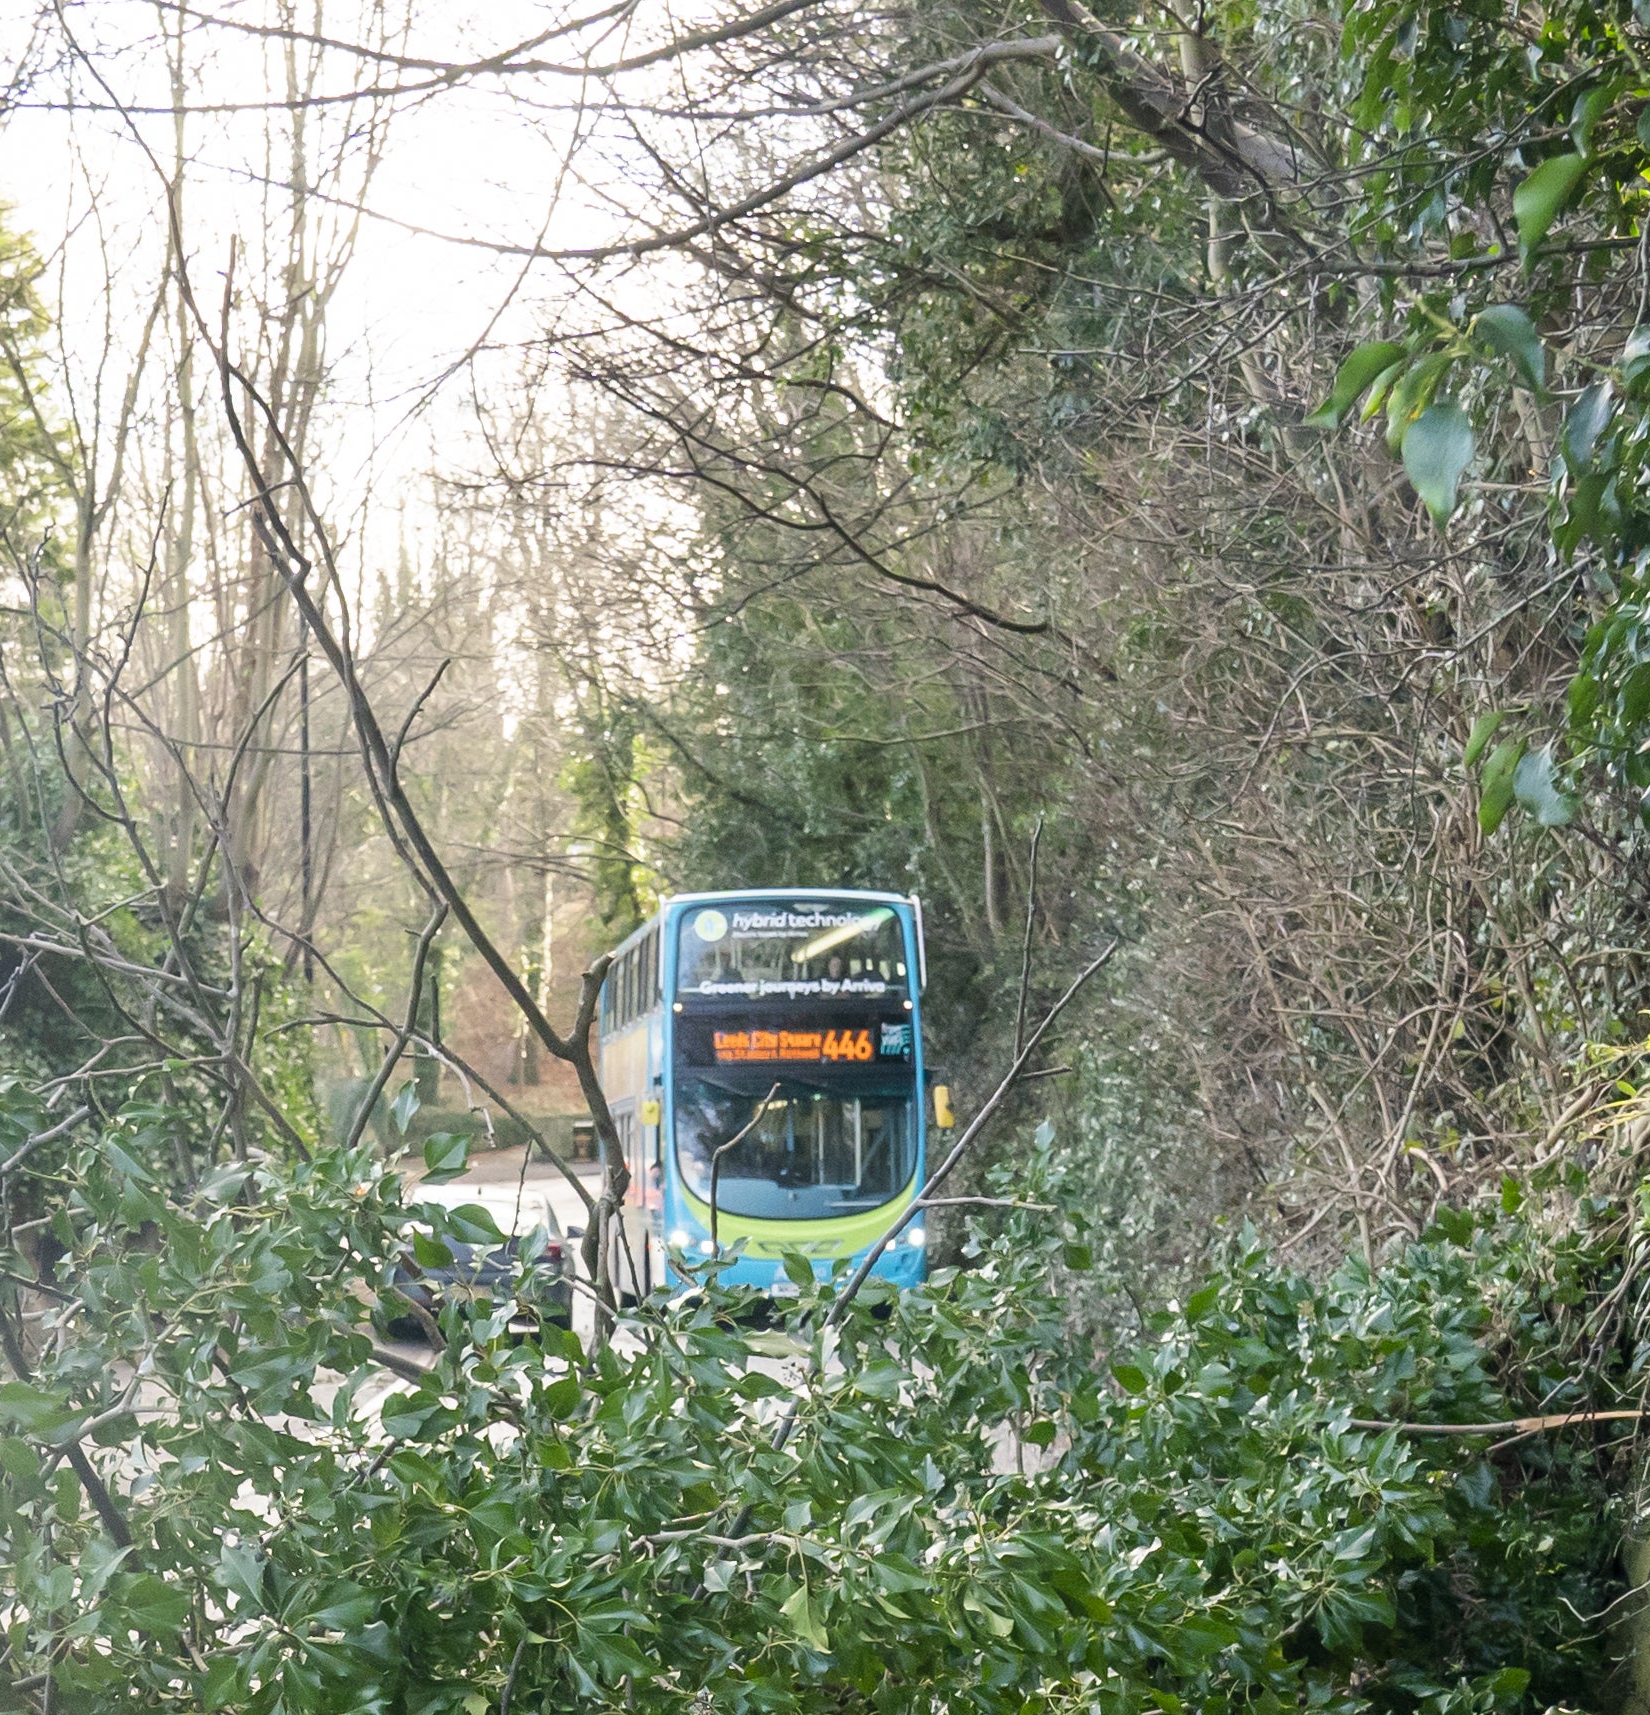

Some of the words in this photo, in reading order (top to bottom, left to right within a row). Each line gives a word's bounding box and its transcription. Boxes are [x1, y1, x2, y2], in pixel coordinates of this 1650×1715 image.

[732, 912, 787, 930] hybrid
[821, 979, 840, 995] by
[841, 979, 885, 993] Arriva
[822, 1030, 873, 1061] 446
